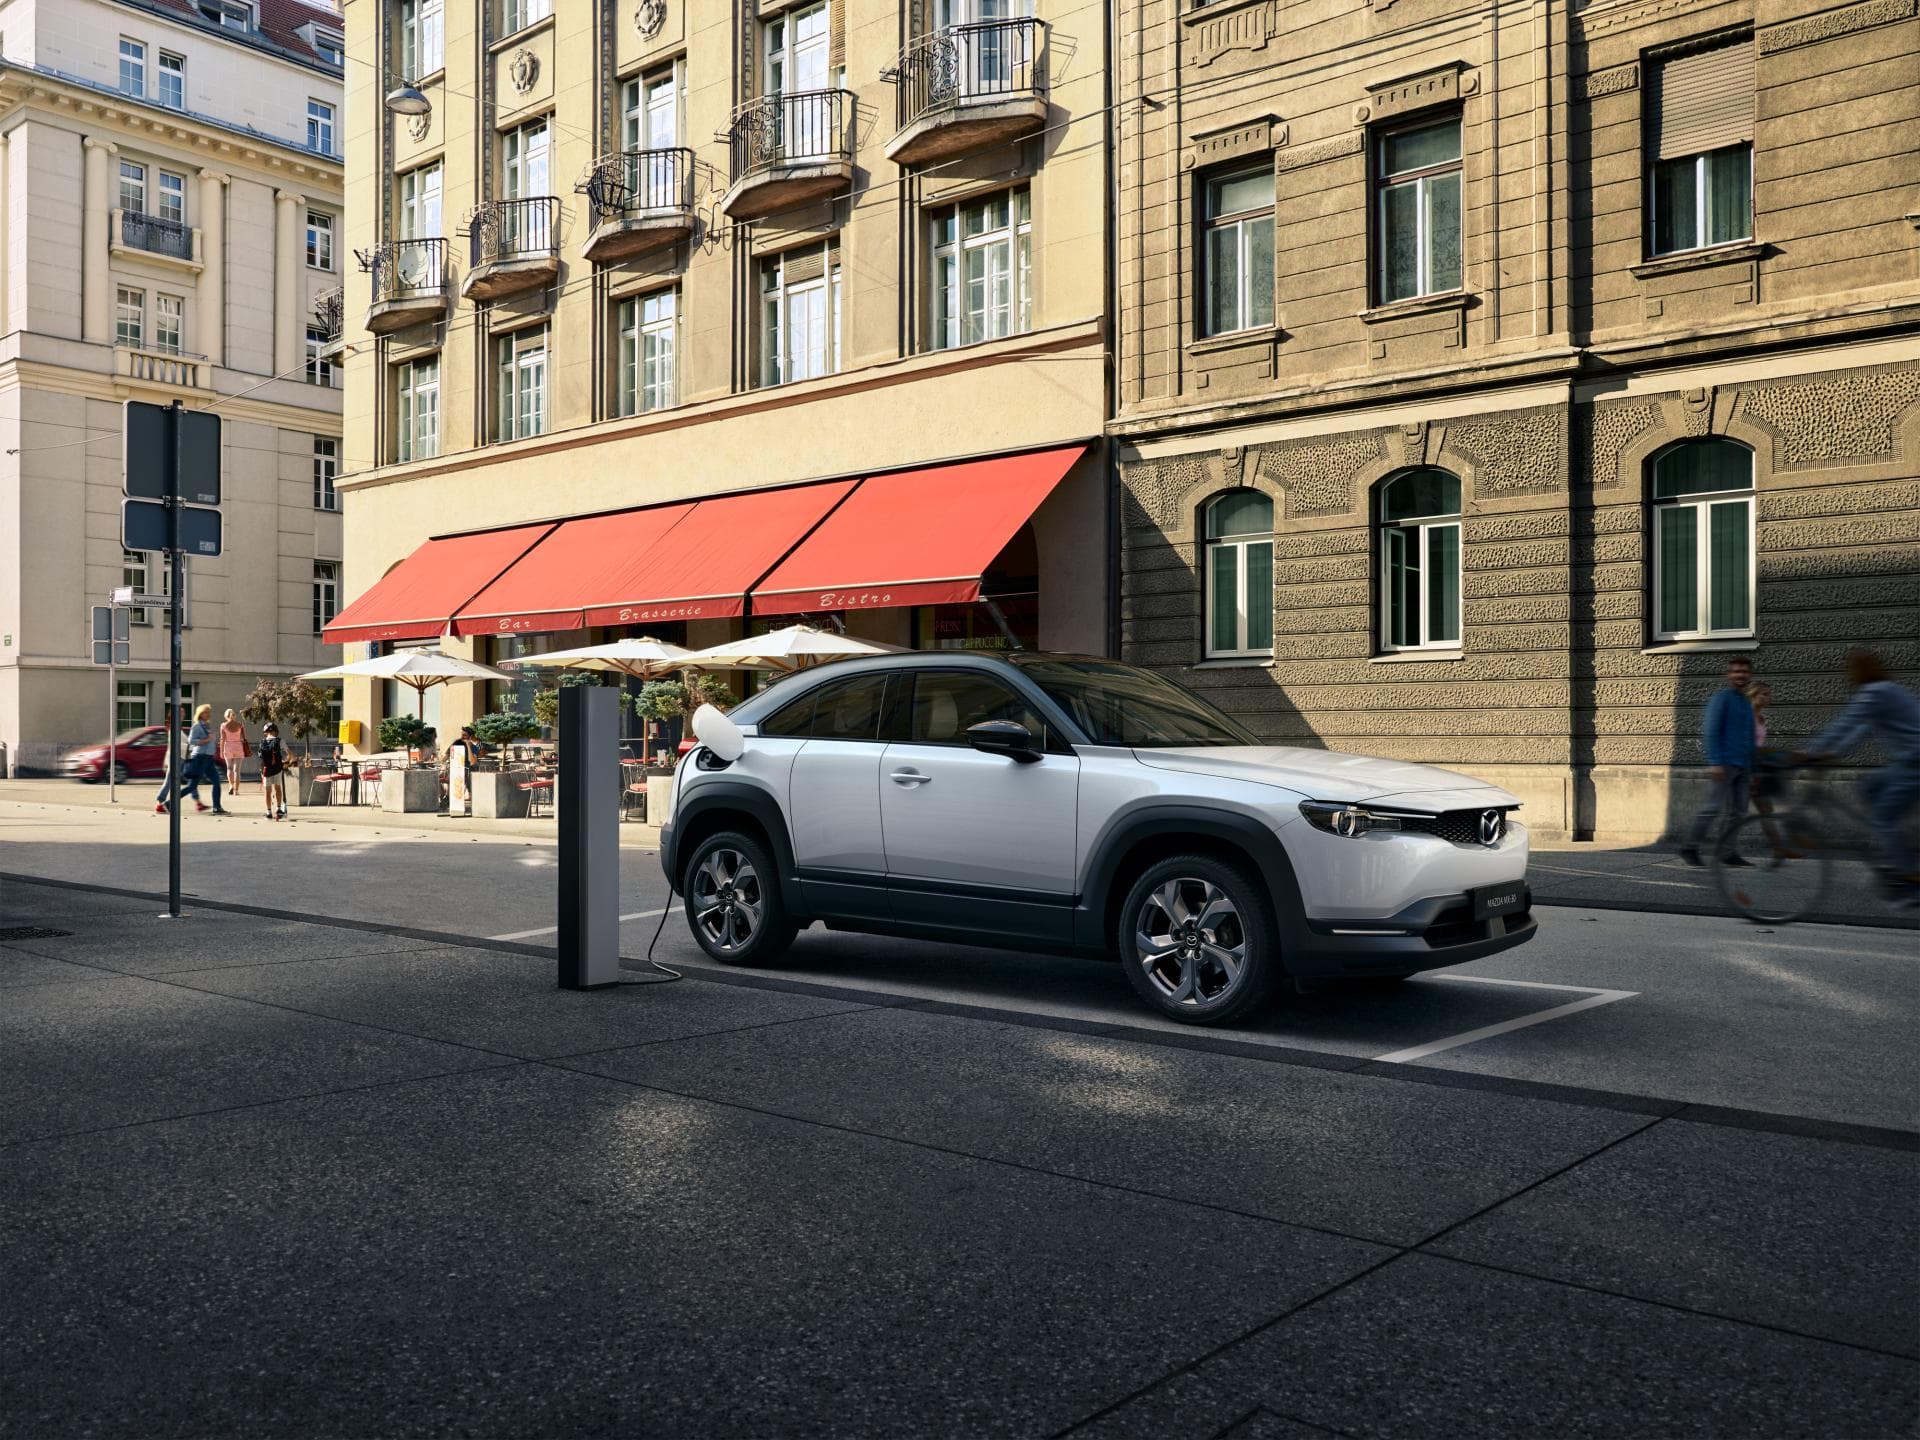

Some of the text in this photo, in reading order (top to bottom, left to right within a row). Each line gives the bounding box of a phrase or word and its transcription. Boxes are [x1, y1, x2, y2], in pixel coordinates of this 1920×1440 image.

[820, 593, 892, 607] Bistro
[618, 606, 702, 622] Brasserie
[498, 618, 531, 630] Bar
